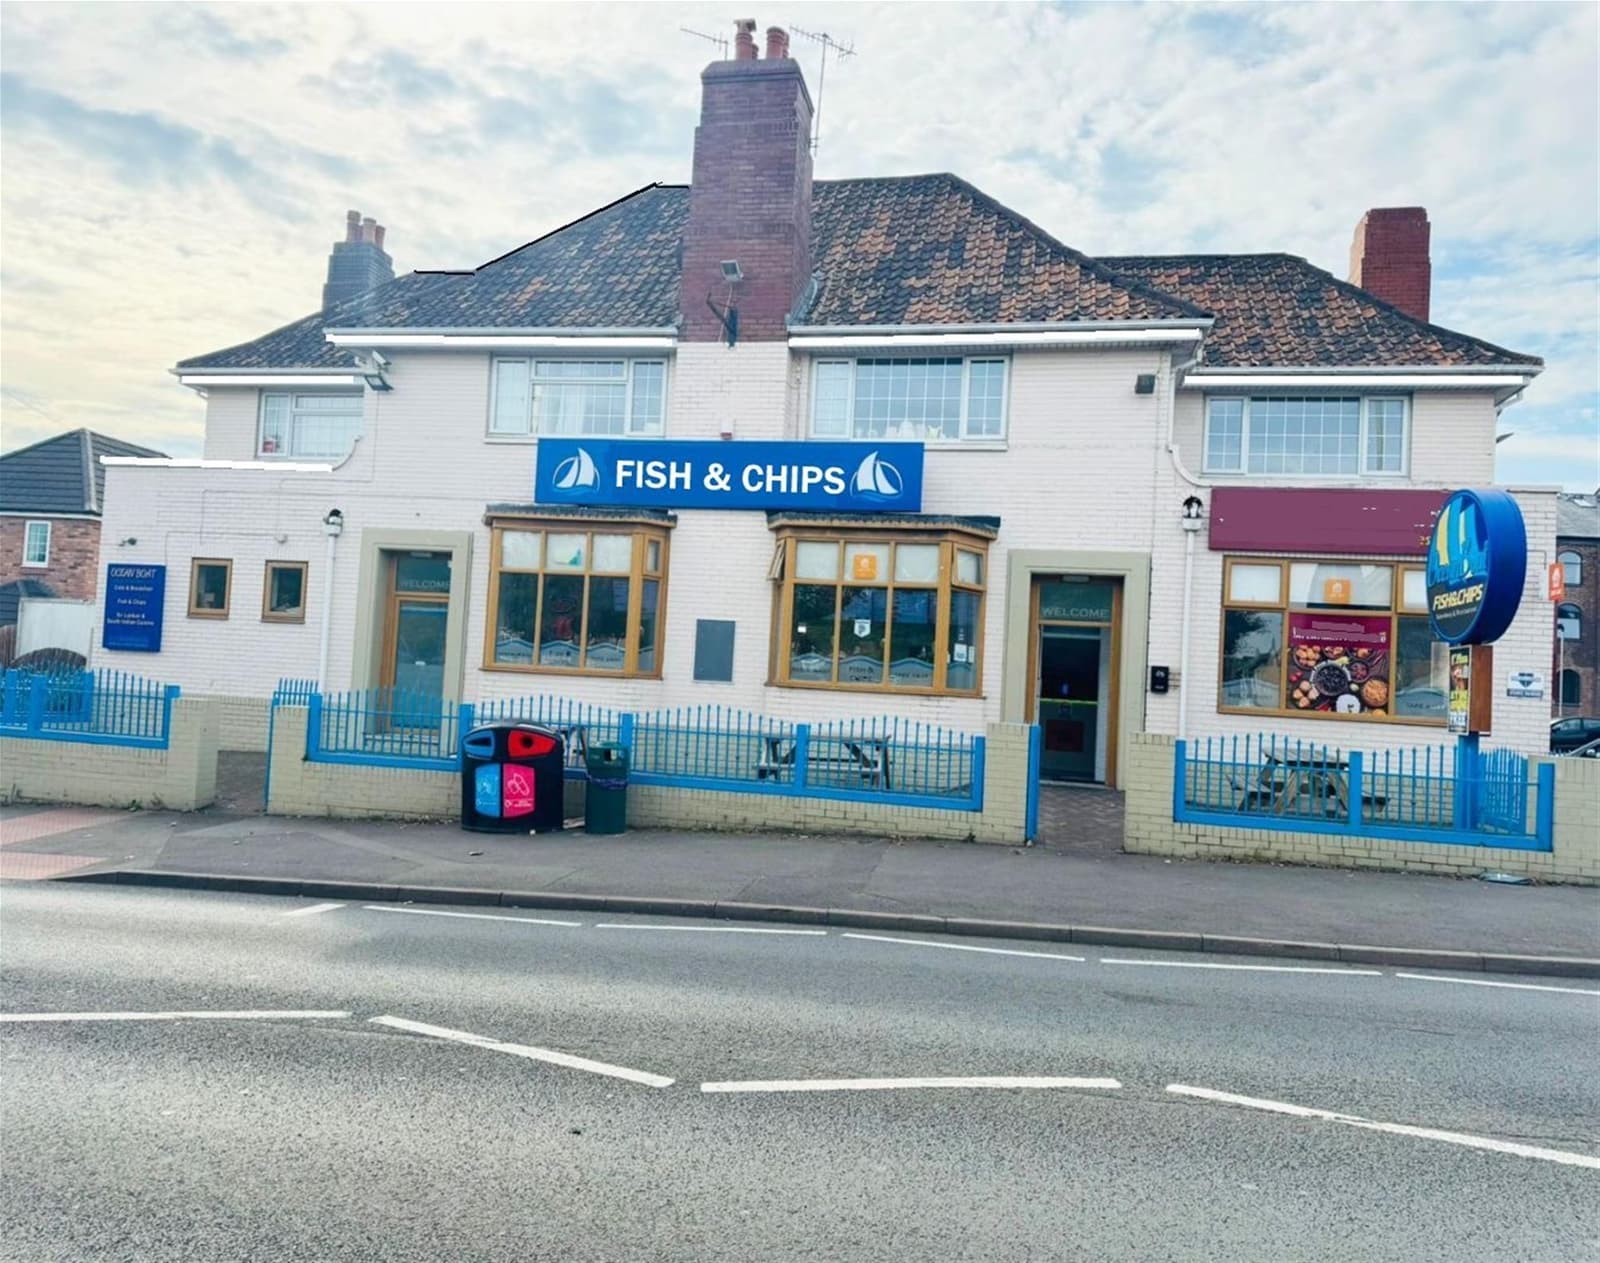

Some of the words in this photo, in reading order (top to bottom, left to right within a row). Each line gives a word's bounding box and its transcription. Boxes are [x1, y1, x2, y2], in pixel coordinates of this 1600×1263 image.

[615, 459, 692, 490] FISH
[703, 463, 731, 491] &
[741, 463, 846, 495] CHIPS
[110, 567, 135, 578] OCEAN
[136, 568, 157, 579] BOAT
[1041, 607, 1109, 617] WELCOME
